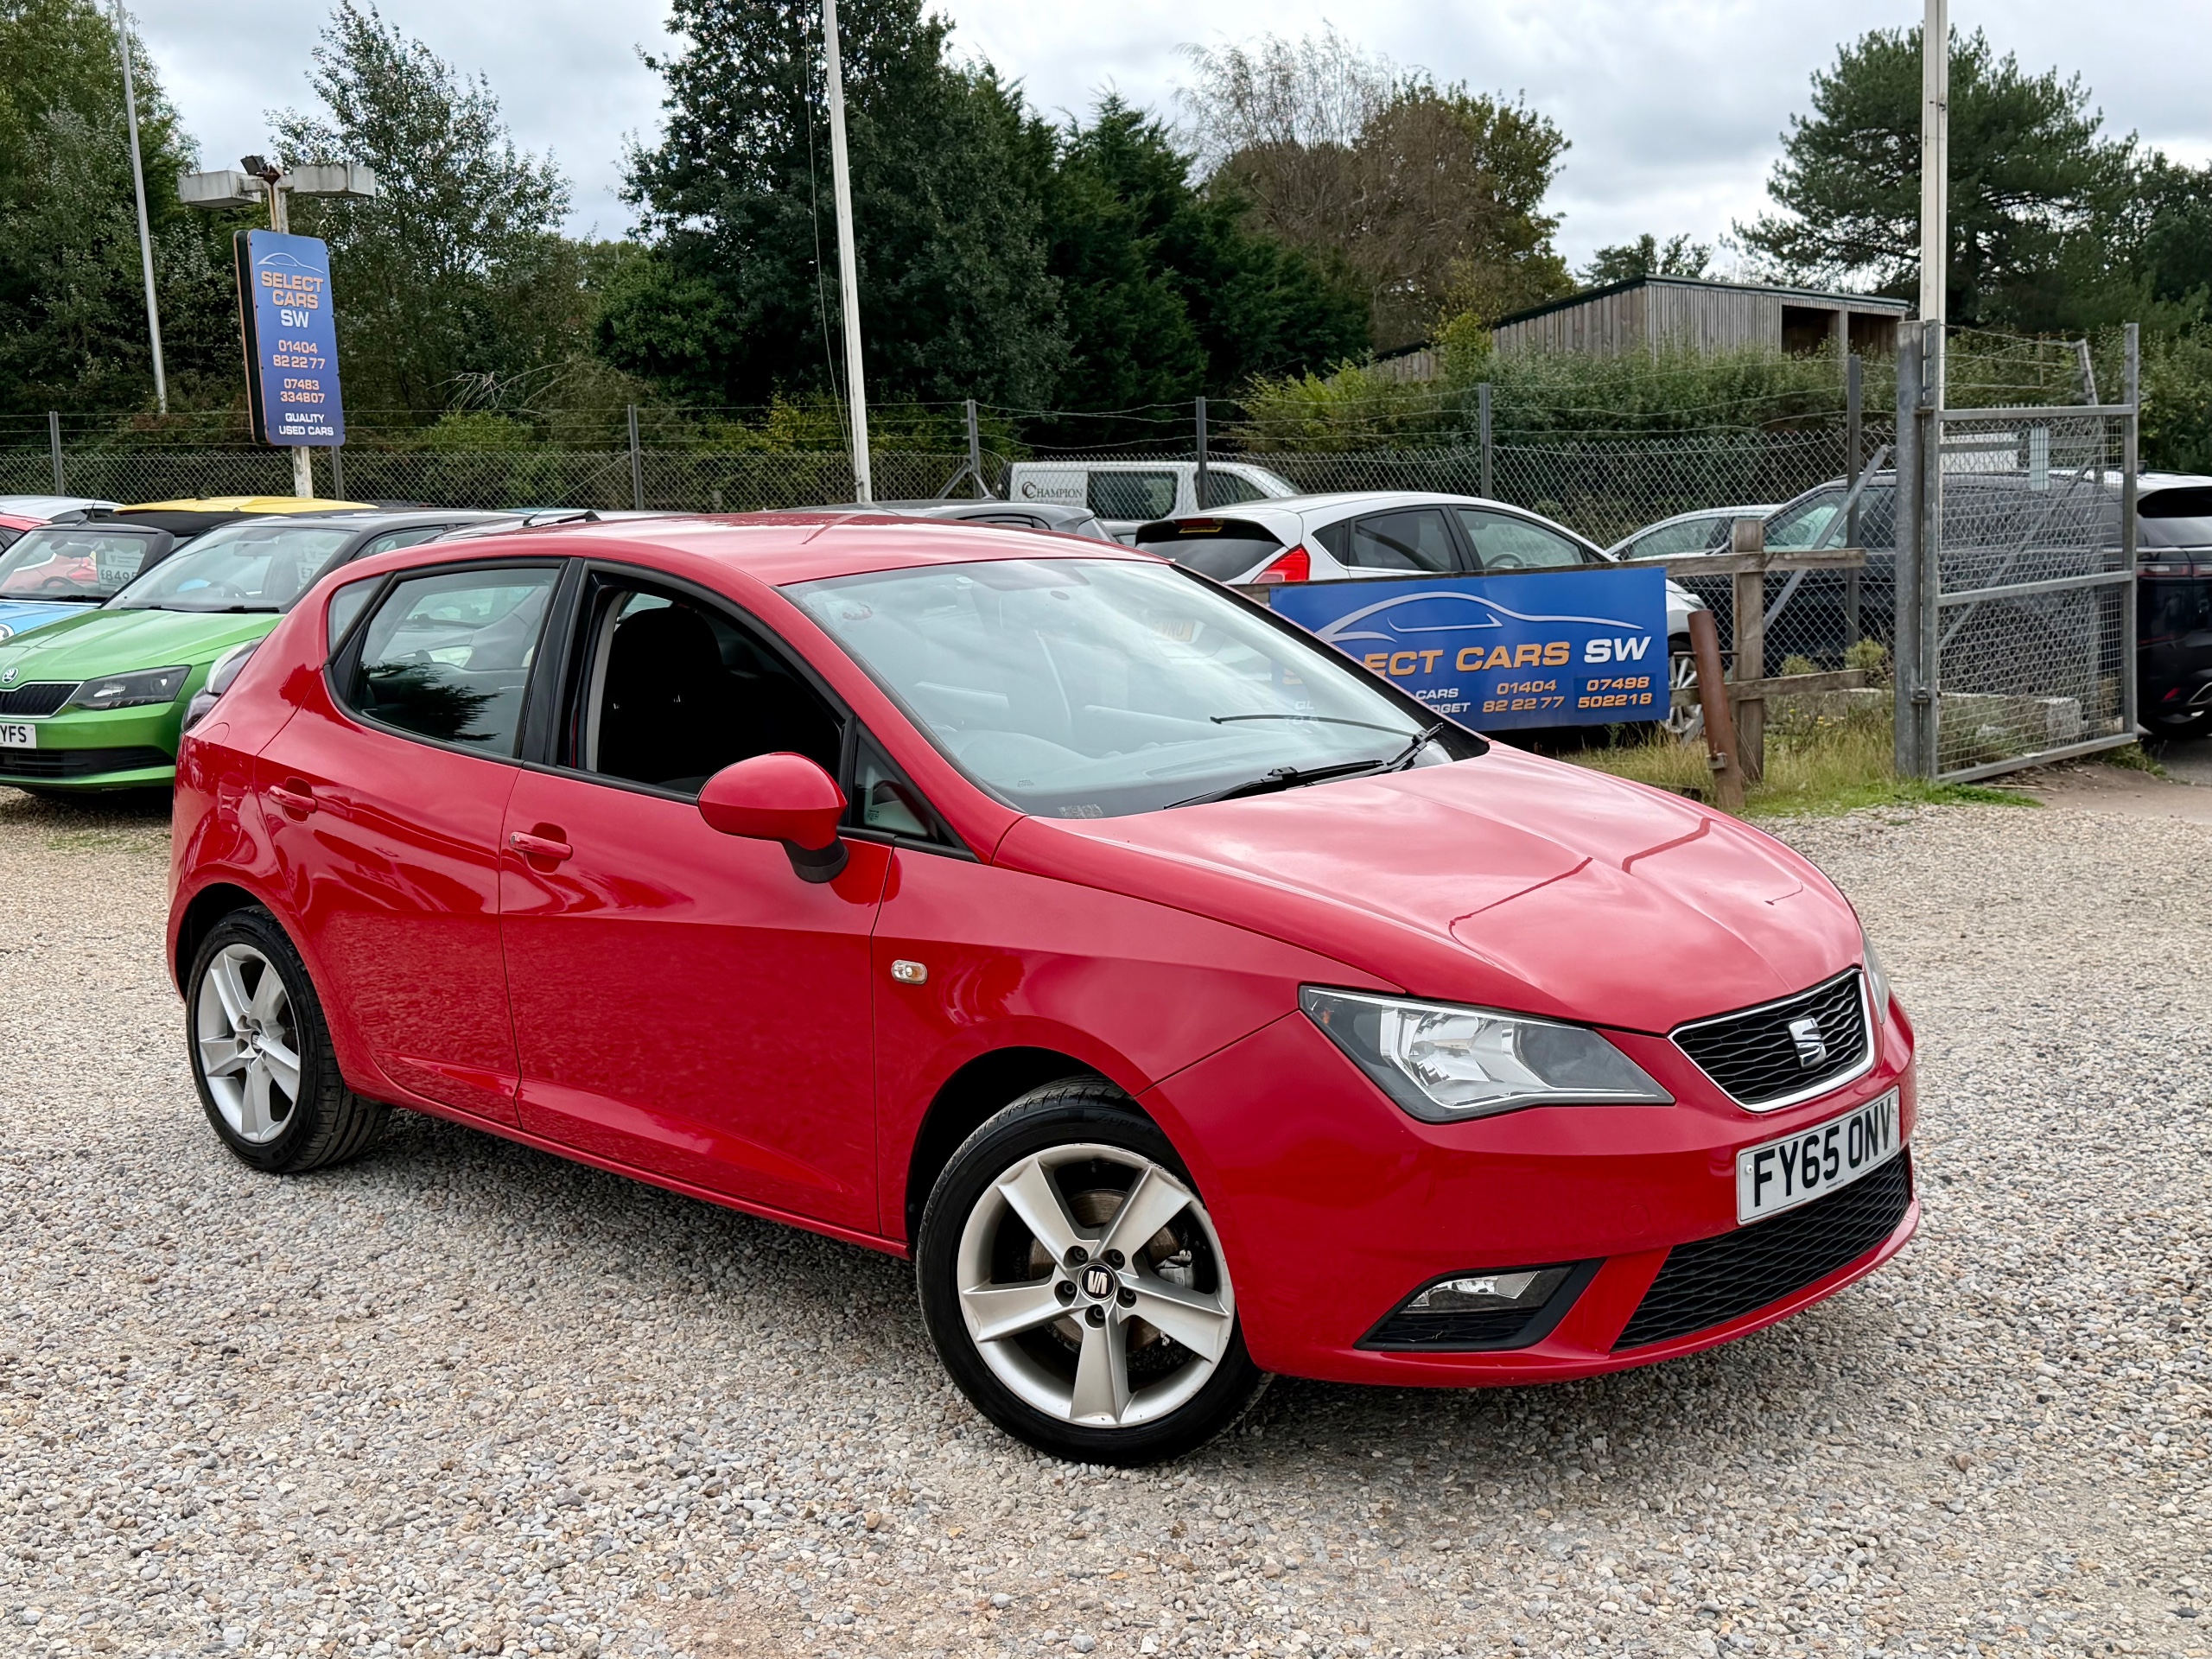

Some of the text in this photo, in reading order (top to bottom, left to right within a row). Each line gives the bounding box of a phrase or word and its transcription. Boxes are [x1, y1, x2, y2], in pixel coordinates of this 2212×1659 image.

[261, 270, 324, 293] SELECT
[272, 290, 319, 309] CARS
[281, 309, 308, 327] SW
[278, 340, 318, 353] 01404
[280, 391, 325, 404] 334807
[285, 413, 325, 423] QUALITY
[279, 425, 334, 436] USED CARS
[1363, 636, 1652, 677] ECT CARS SW
[1496, 680, 1557, 695] 01404
[1586, 677, 1649, 691] 07498
[1415, 687, 1459, 700] CARS
[1577, 692, 1652, 709] 502218
[0, 725, 27, 743] YFS
[1754, 1097, 1891, 1208] FY65 ONV
